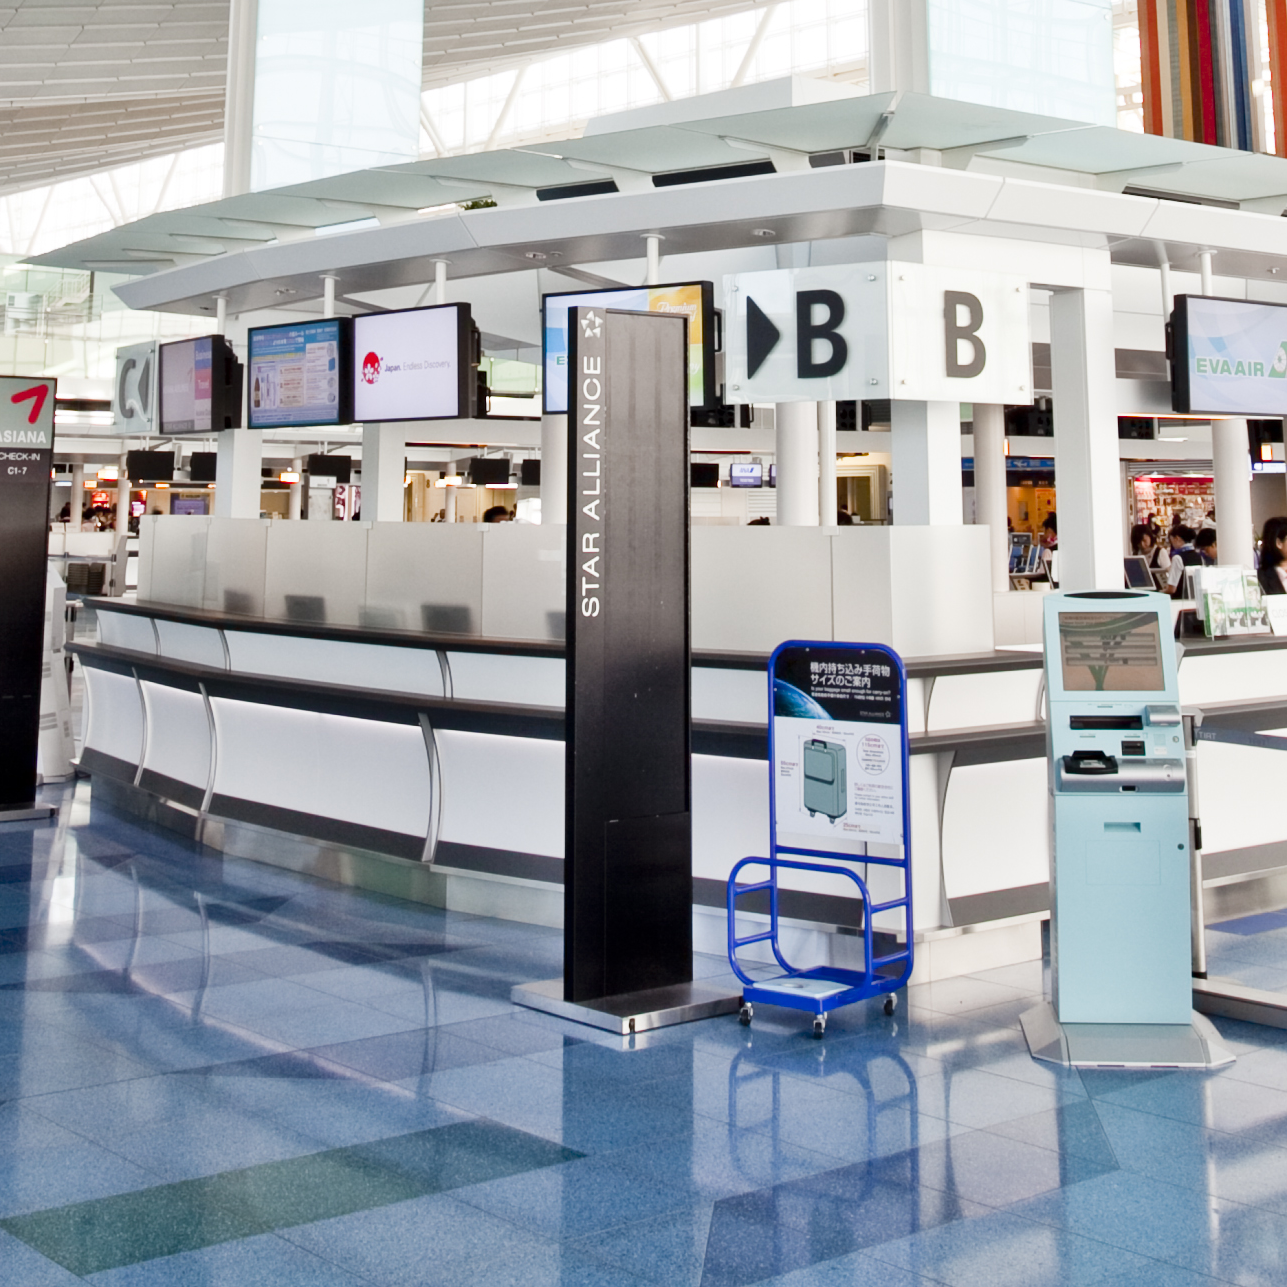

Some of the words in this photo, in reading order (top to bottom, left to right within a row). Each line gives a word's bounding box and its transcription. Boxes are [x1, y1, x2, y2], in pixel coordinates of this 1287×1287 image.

[796, 289, 848, 379] B
[944, 290, 987, 378] B
[118, 358, 137, 419] C
[384, 363, 401, 373] Japan.
[403, 361, 423, 371] Endless
[582, 356, 602, 521] ALLIANCE
[7, 466, 28, 476] C1-7
[581, 532, 601, 617] STAR
[810, 661, 891, 677] 機内持ち込み手荷物
[810, 674, 871, 689] サイズのご案内
